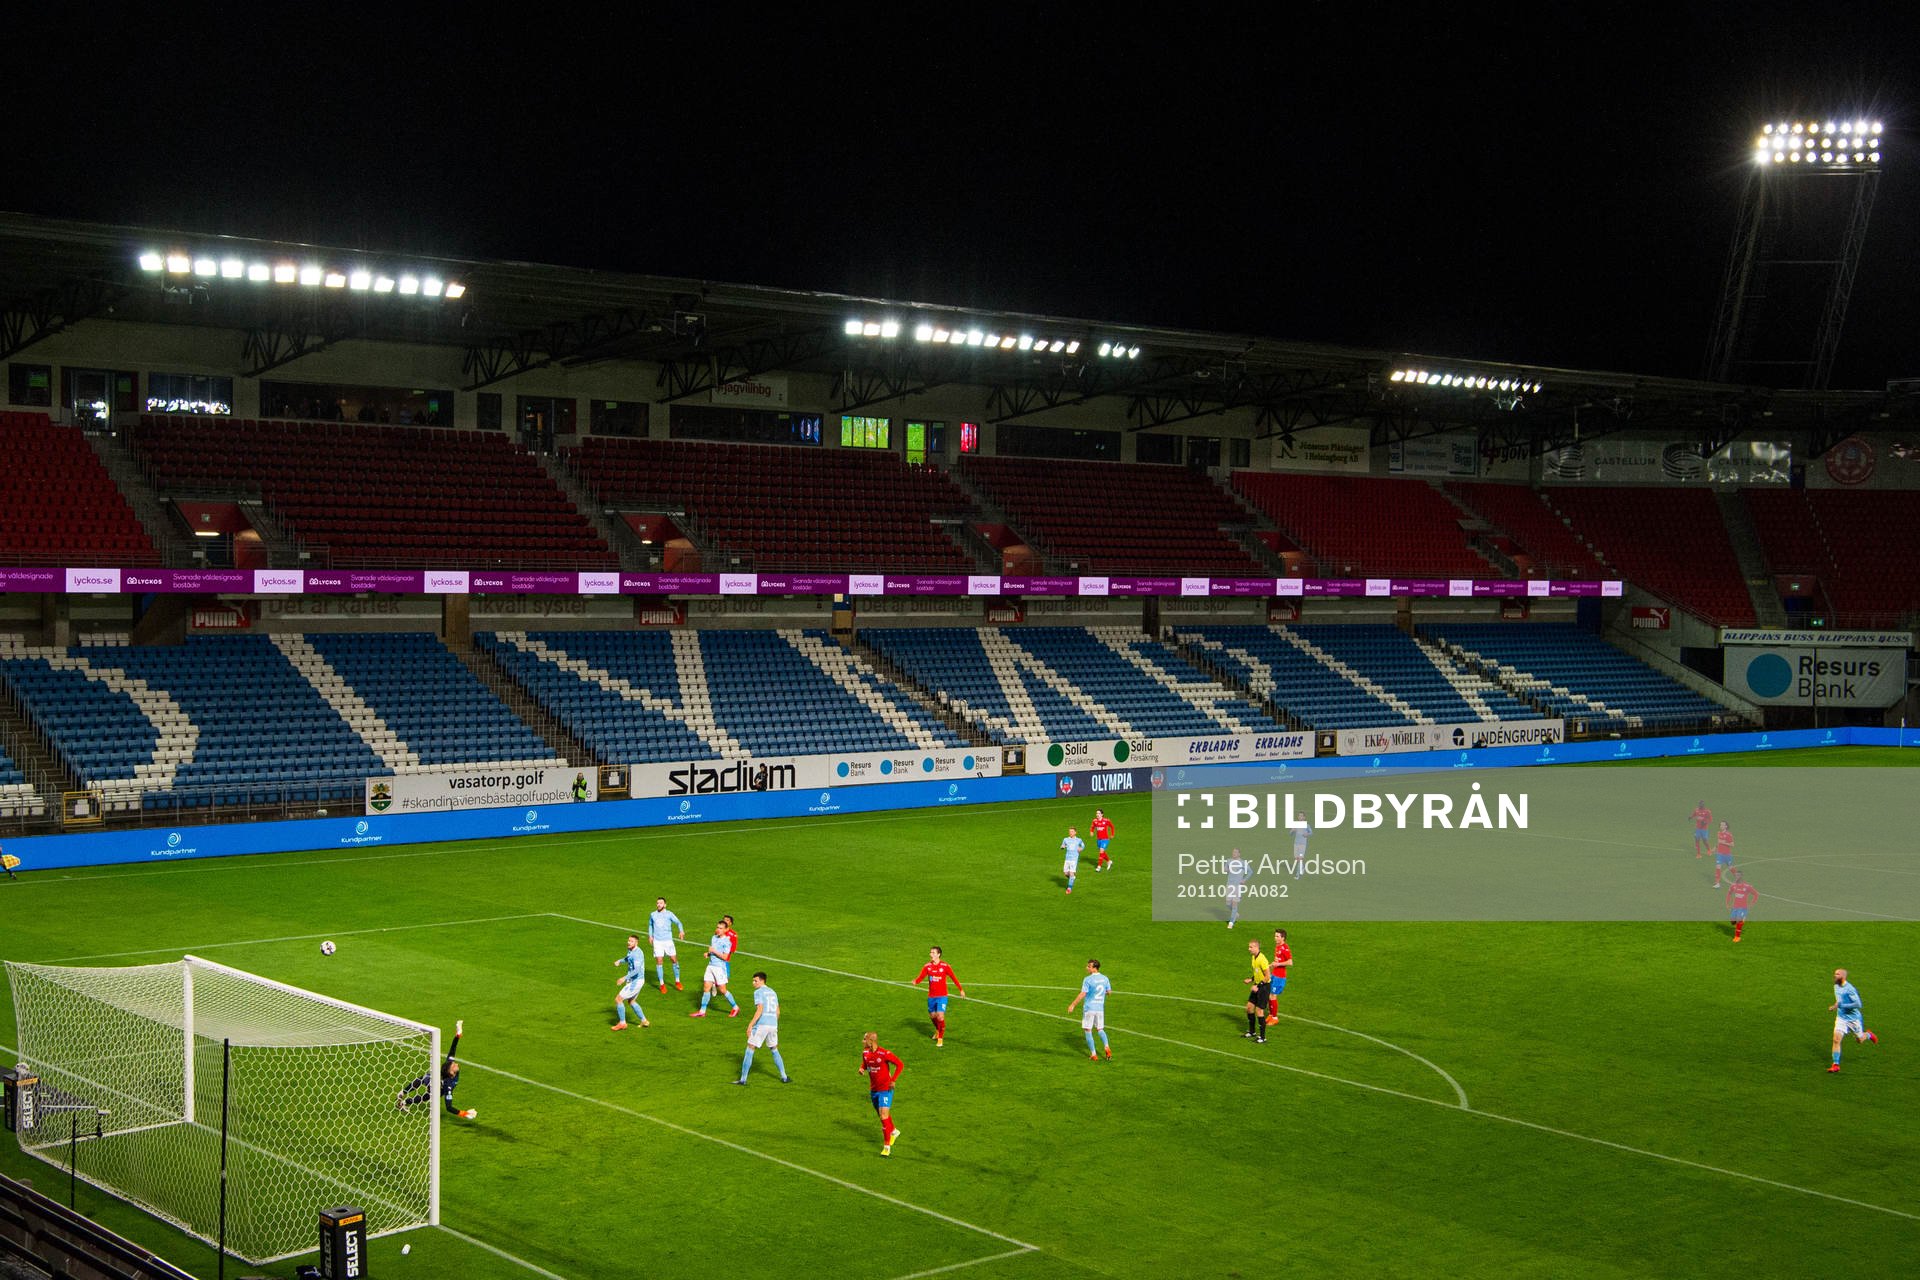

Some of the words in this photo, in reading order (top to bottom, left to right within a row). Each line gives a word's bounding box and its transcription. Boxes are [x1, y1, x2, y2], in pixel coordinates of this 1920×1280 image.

[1594, 457, 1656, 466] CASTELLUM
[74, 576, 113, 586] lyckos.se
[261, 577, 297, 587] lyckos.se
[431, 578, 463, 587] lyckos.se
[584, 579, 614, 588] lyckos.se
[725, 580, 752, 588] lyckos.se
[854, 581, 878, 589] lyckos.se
[973, 582, 996, 590] lyckos.se
[195, 611, 239, 627] PUMA
[641, 610, 675, 624] PUMA
[988, 609, 1016, 621] PUMA
[1633, 617, 1661, 630] PUMA
[1724, 633, 1781, 641] KLIPPANS
[1784, 633, 1815, 641] BUSS
[1818, 634, 1876, 642] KLIPPANS
[1879, 635, 1909, 643] BUSS
[1798, 655, 1881, 677] Resurs
[1798, 678, 1856, 698] Bank
[1255, 735, 1303, 750] EKBLADHS
[1392, 730, 1426, 746] MÖBLER
[1065, 743, 1088, 757] Solid
[1131, 740, 1153, 753] Solid
[1189, 739, 1240, 753] EKBLADHS
[894, 759, 915, 768] Resurs
[935, 757, 956, 766] Resurs
[976, 755, 996, 763] Resurs
[1065, 757, 1095, 768] Försäkring
[1131, 754, 1159, 765] Försäkring
[851, 761, 872, 770] Resurs
[976, 762, 990, 771] Bank
[669, 760, 796, 796] stadium
[851, 769, 866, 777] Bank
[449, 771, 544, 790] vasatorp.golf
[1091, 772, 1133, 792] OLYMPIA
[402, 788, 593, 810] #skandinaviensbästagolfuppleve
[809, 804, 840, 812] Kundpartner
[513, 824, 550, 832] Kundpartner
[341, 835, 382, 844] Kundpartner
[151, 848, 196, 857] Kundpartner
[1095, 984, 1104, 1000] 2
[766, 996, 777, 1012] 15
[23, 1090, 34, 1129] SELECT
[323, 1231, 332, 1279] SELECT
[346, 1230, 360, 1278] SELECT
